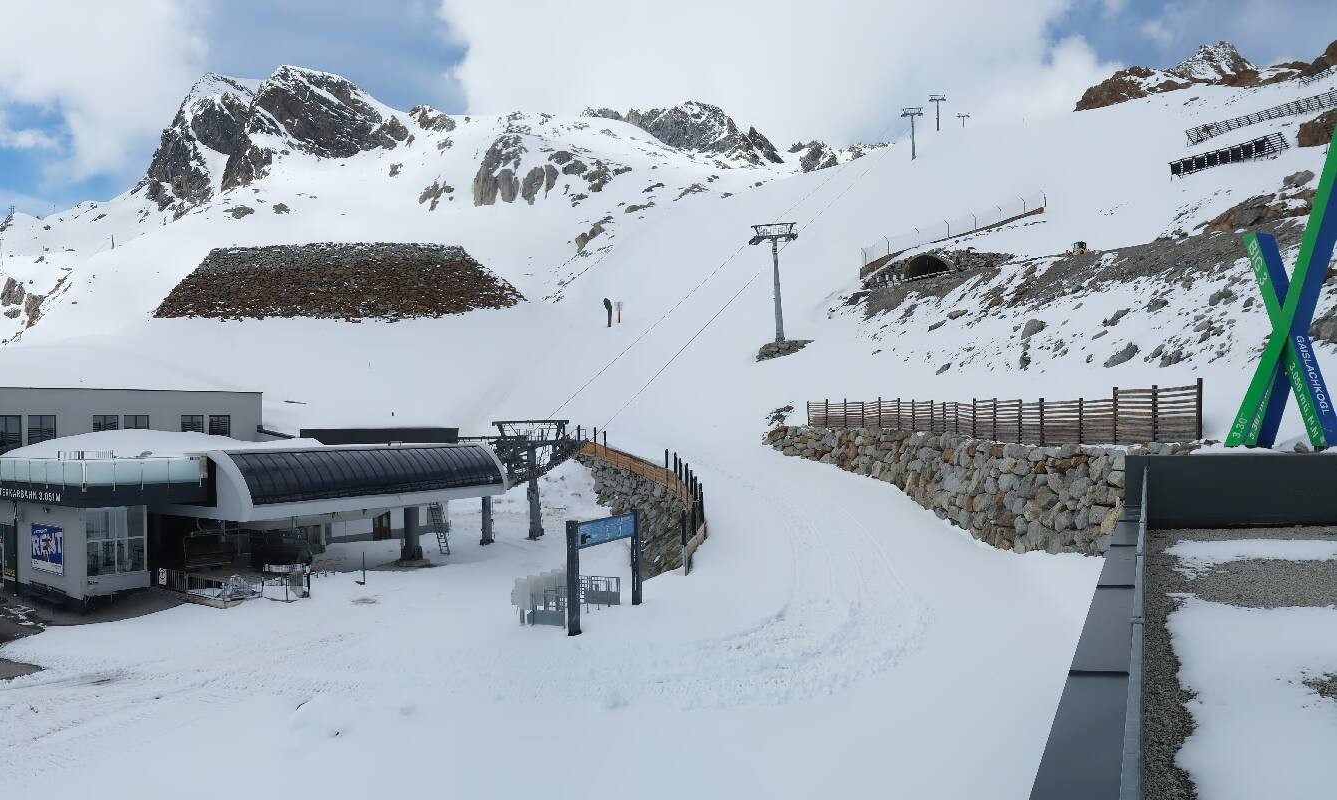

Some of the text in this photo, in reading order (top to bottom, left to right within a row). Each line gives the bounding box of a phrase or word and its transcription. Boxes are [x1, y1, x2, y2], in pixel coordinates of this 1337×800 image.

[1249, 238, 1267, 285] BIG 3
[1296, 335, 1330, 415] GAISLACHKOGL
[31, 530, 63, 556] RENT
